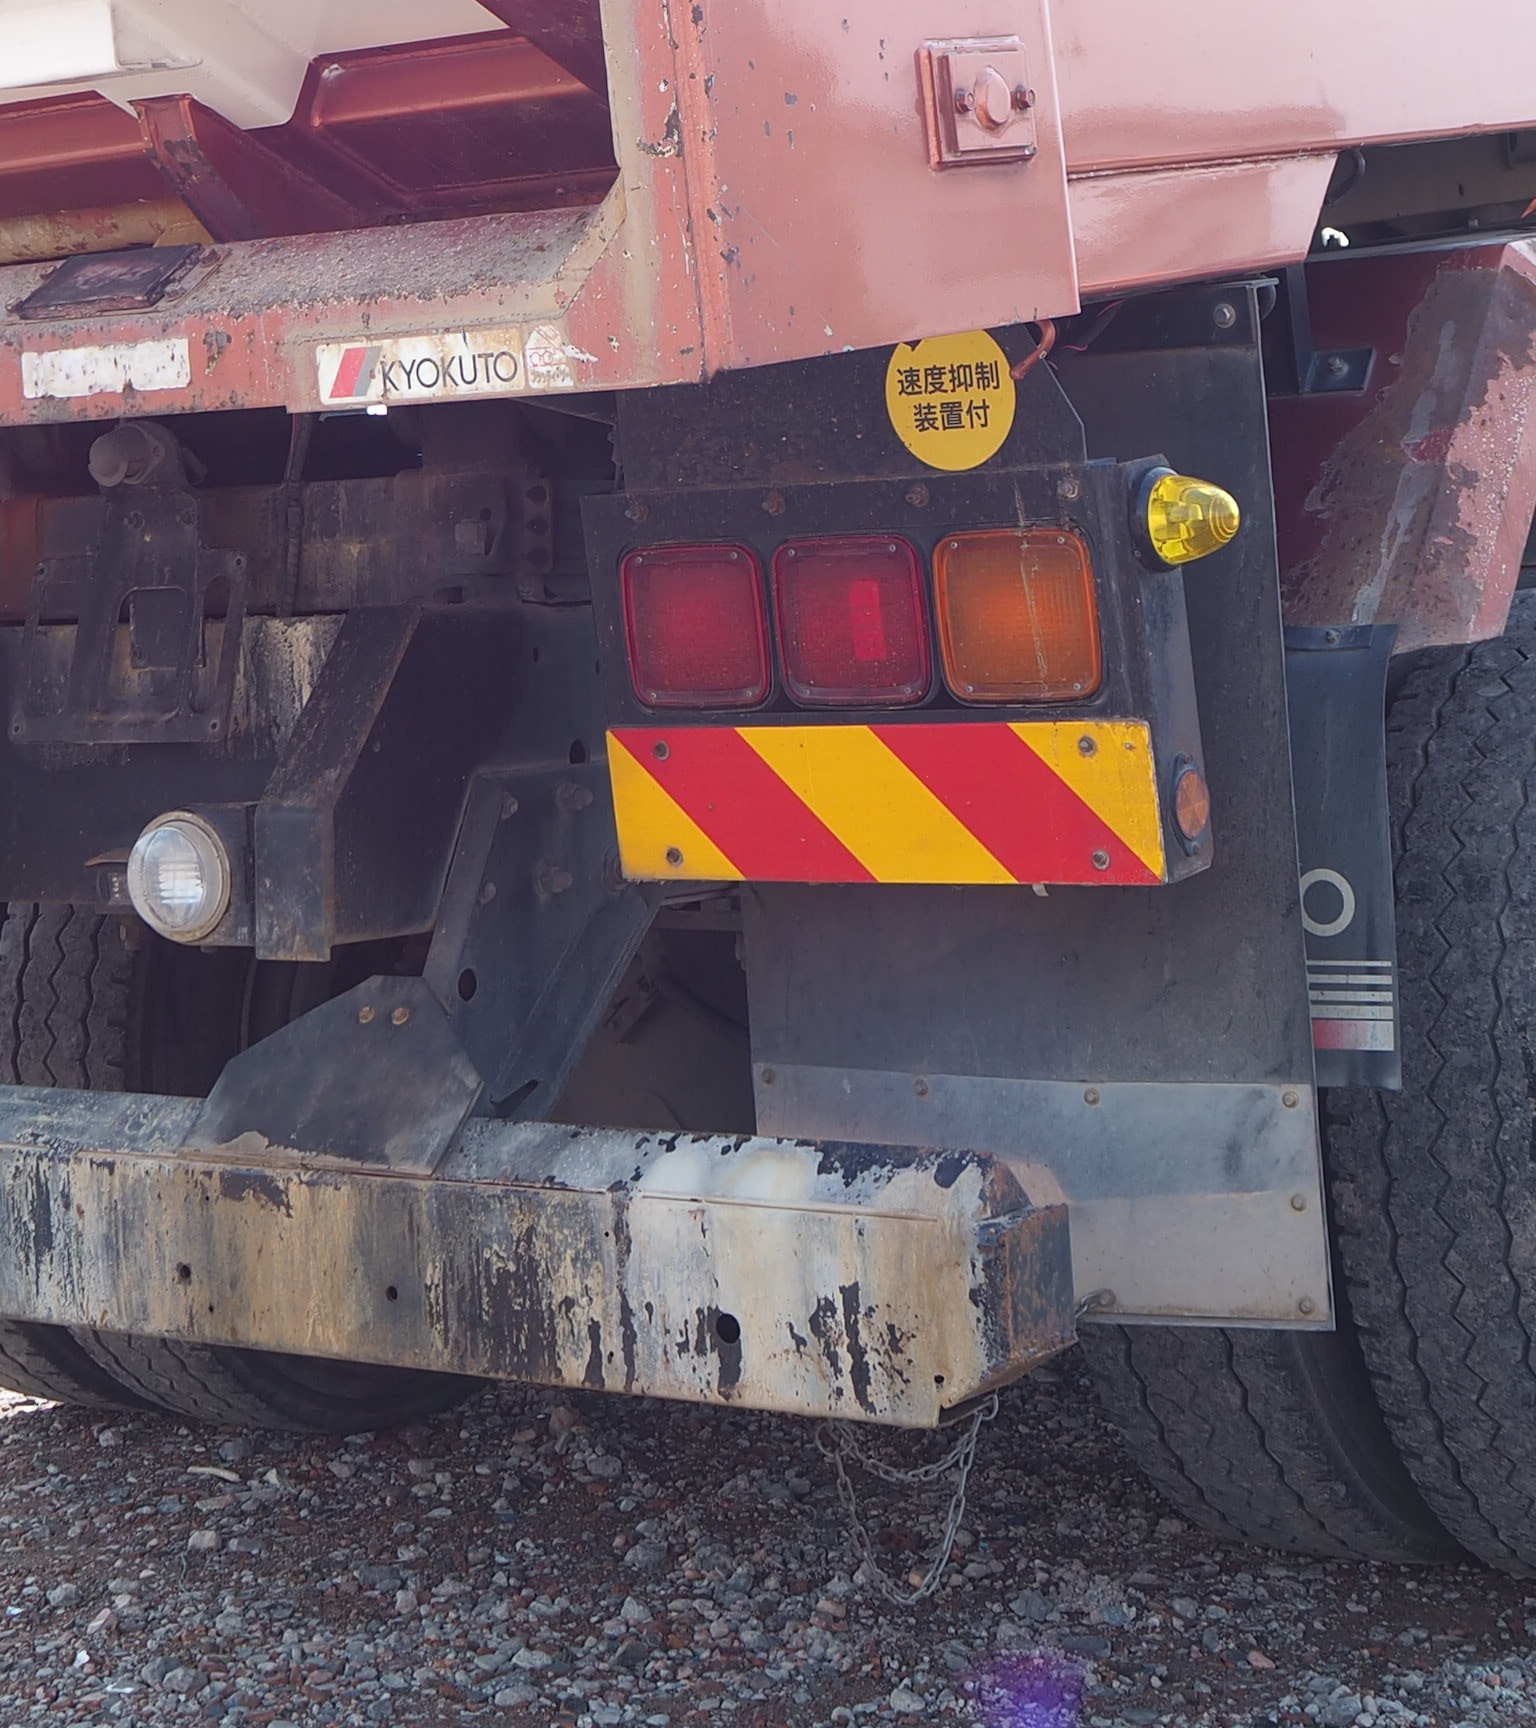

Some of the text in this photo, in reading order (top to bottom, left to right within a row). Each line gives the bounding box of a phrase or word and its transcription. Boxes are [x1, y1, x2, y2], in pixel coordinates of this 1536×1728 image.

[380, 351, 518, 392] KYOKUTO
[896, 360, 1000, 396] 速度抑制
[913, 399, 990, 432] 装置付
